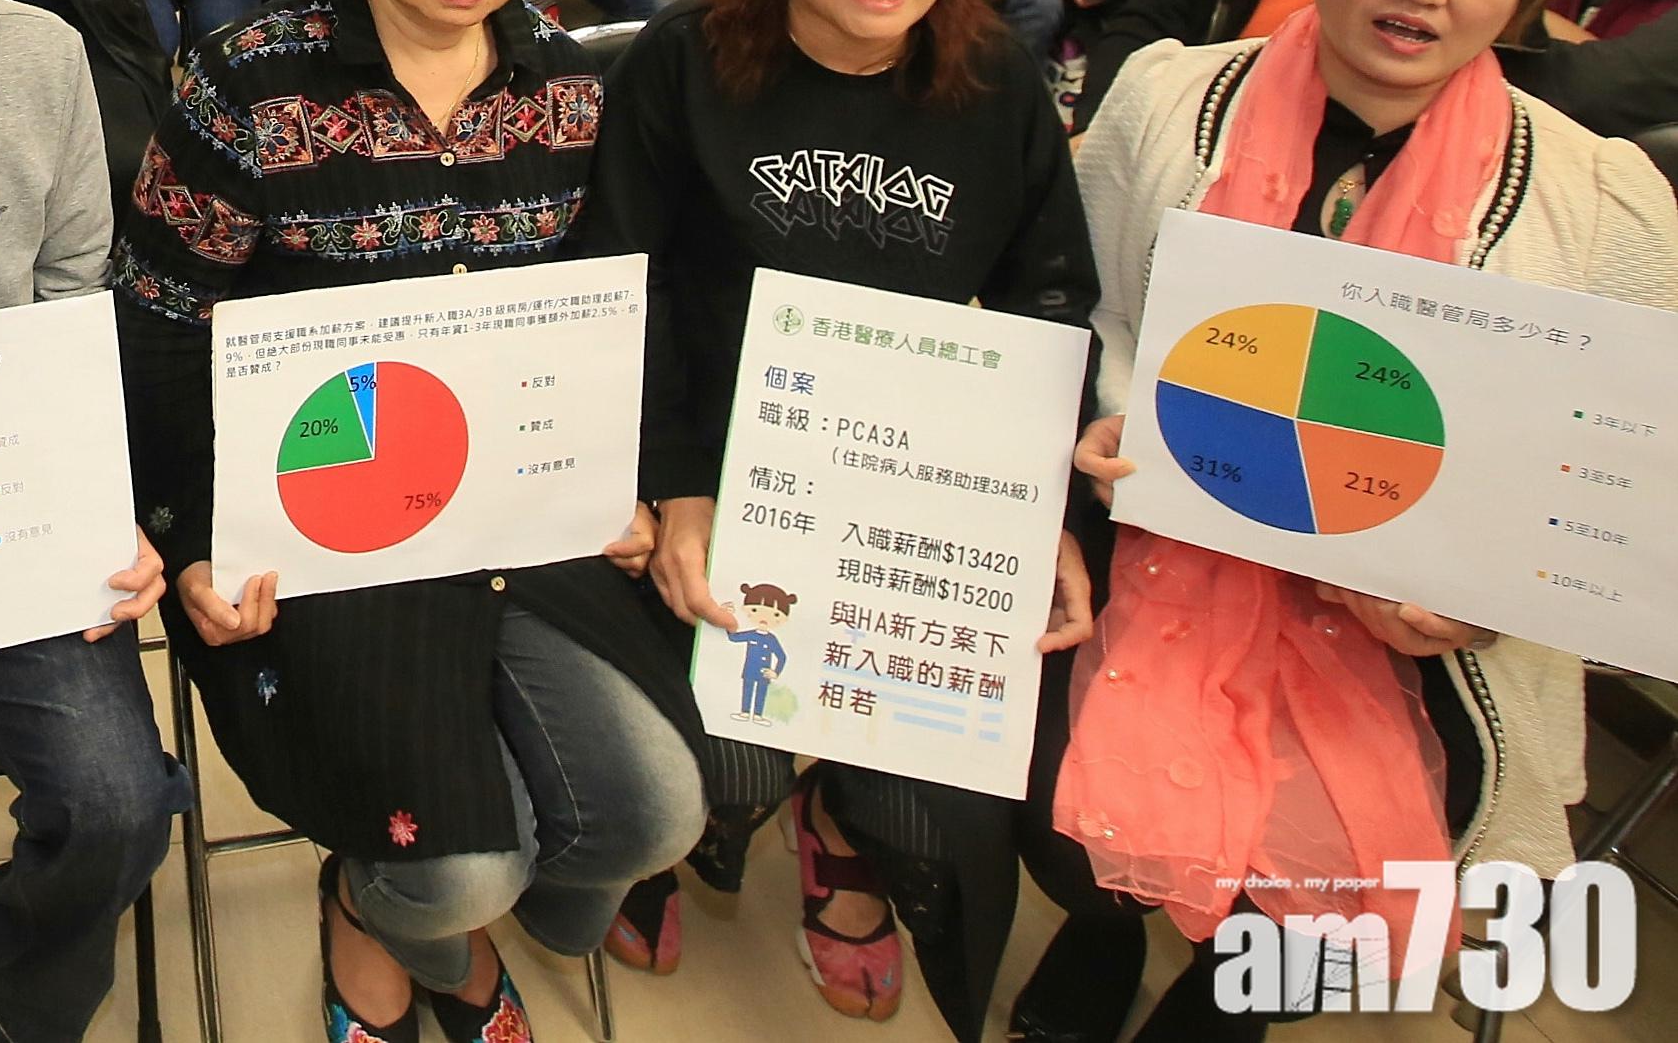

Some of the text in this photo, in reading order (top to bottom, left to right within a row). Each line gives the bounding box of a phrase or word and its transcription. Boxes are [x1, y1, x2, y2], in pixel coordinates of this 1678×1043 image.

[749, 149, 955, 222] CATALOG
[1341, 281, 1592, 352] 你入職醫管局多少年？
[812, 317, 1003, 369] 香港醫療人員總工會
[1204, 327, 1259, 355] 24%
[349, 373, 378, 393] 5%
[532, 375, 555, 388] 反對
[764, 365, 815, 397] 個案
[1355, 362, 1412, 391] 24%
[299, 418, 339, 438] 20%
[1592, 414, 1658, 438] 3年以下
[1190, 455, 1242, 484] 31%
[1578, 467, 1634, 489] 3至5年
[1344, 471, 1402, 502] 21%
[404, 493, 442, 512] 75%
[742, 503, 1019, 577] 2016年 入職薪酬$13420
[1563, 520, 1630, 546] 5至10年
[836, 559, 1014, 612] 現時薪酬$15200
[1551, 573, 1623, 604] 10年以上
[829, 600, 1010, 658] 與HA新方案下
[823, 641, 1007, 703] 新入職的薪酬
[818, 680, 877, 716] 相若
